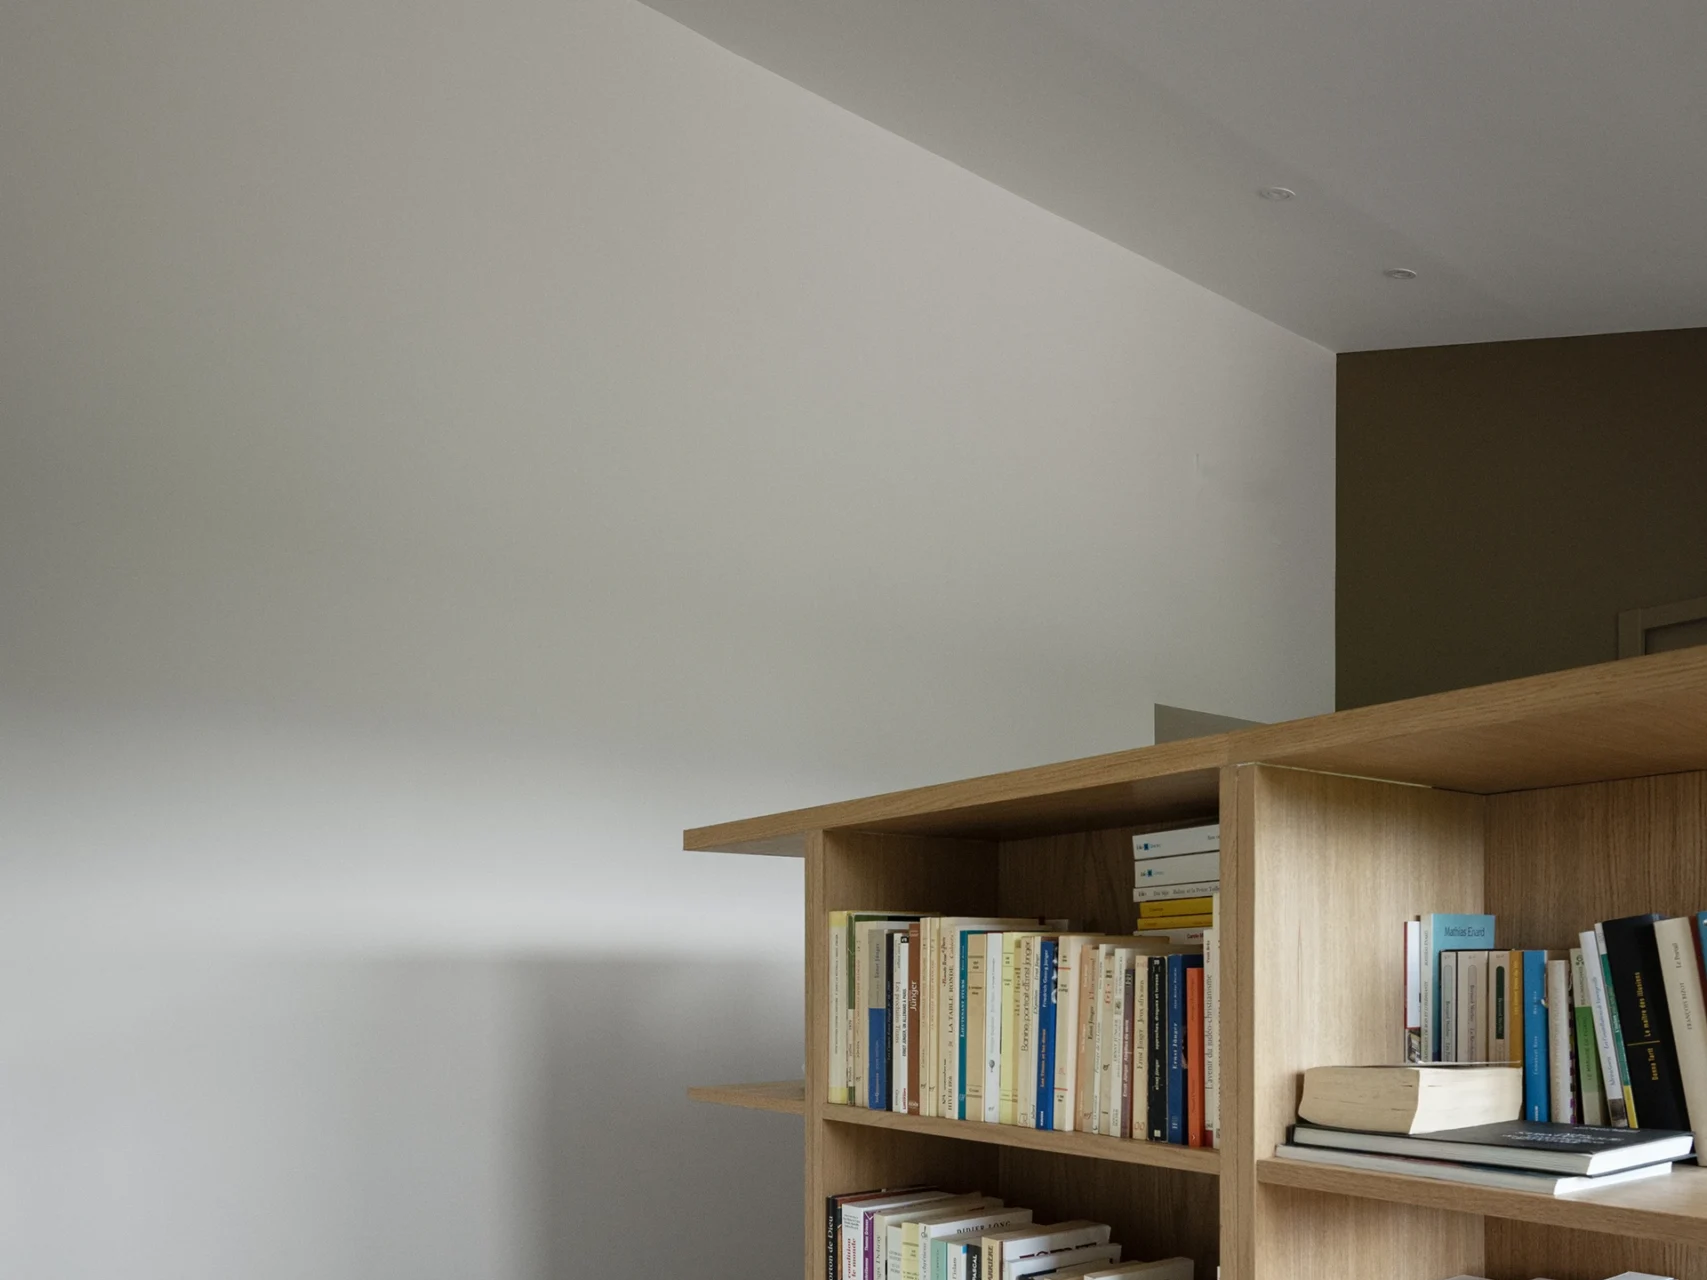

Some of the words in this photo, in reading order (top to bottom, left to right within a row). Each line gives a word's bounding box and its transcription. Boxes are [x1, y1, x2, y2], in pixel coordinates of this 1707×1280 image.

[1444, 927, 1466, 936] Mathias
[1468, 927, 1485, 937] Enard
[1634, 972, 1646, 997] illusions
[910, 980, 919, 1011] Jünger
[1639, 998, 1647, 1008] des
[1640, 1009, 1650, 1028] maître
[1647, 1048, 1655, 1061] Tartt
[1650, 1063, 1659, 1080] Donna
[828, 1242, 833, 1253] de
